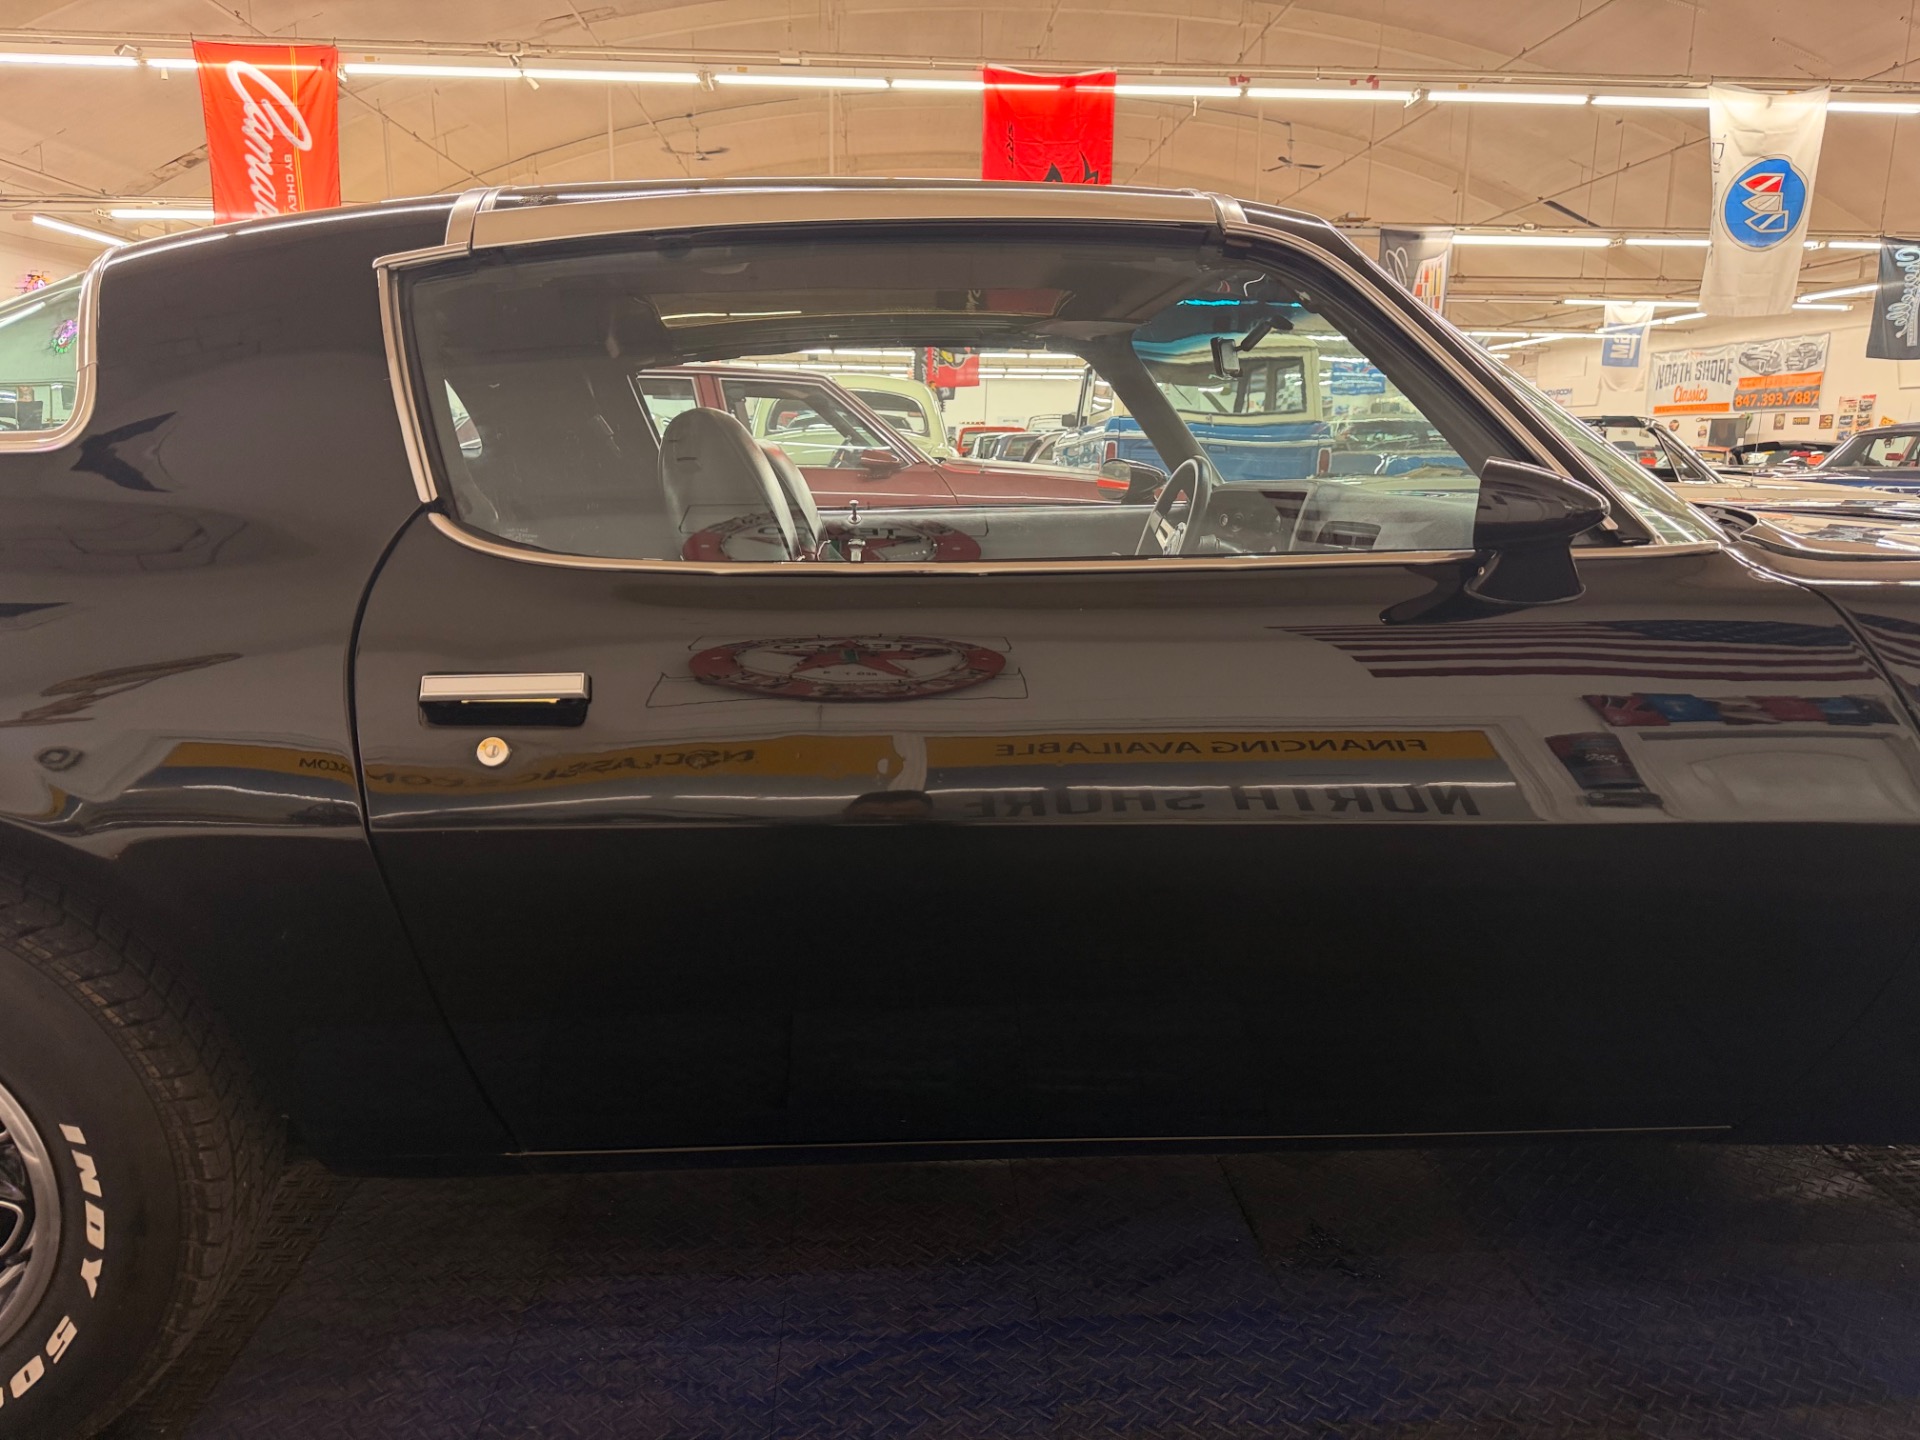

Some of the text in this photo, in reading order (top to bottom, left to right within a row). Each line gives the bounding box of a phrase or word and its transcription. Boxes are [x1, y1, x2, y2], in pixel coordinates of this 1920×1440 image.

[284, 154, 293, 170] BY
[1655, 361, 1692, 390] NORTH
[1695, 358, 1734, 385] SHORE
[1673, 385, 1708, 403] Classics
[1735, 391, 1820, 408] 847.393.7887
[0, 1123, 105, 1409] INDY 50
